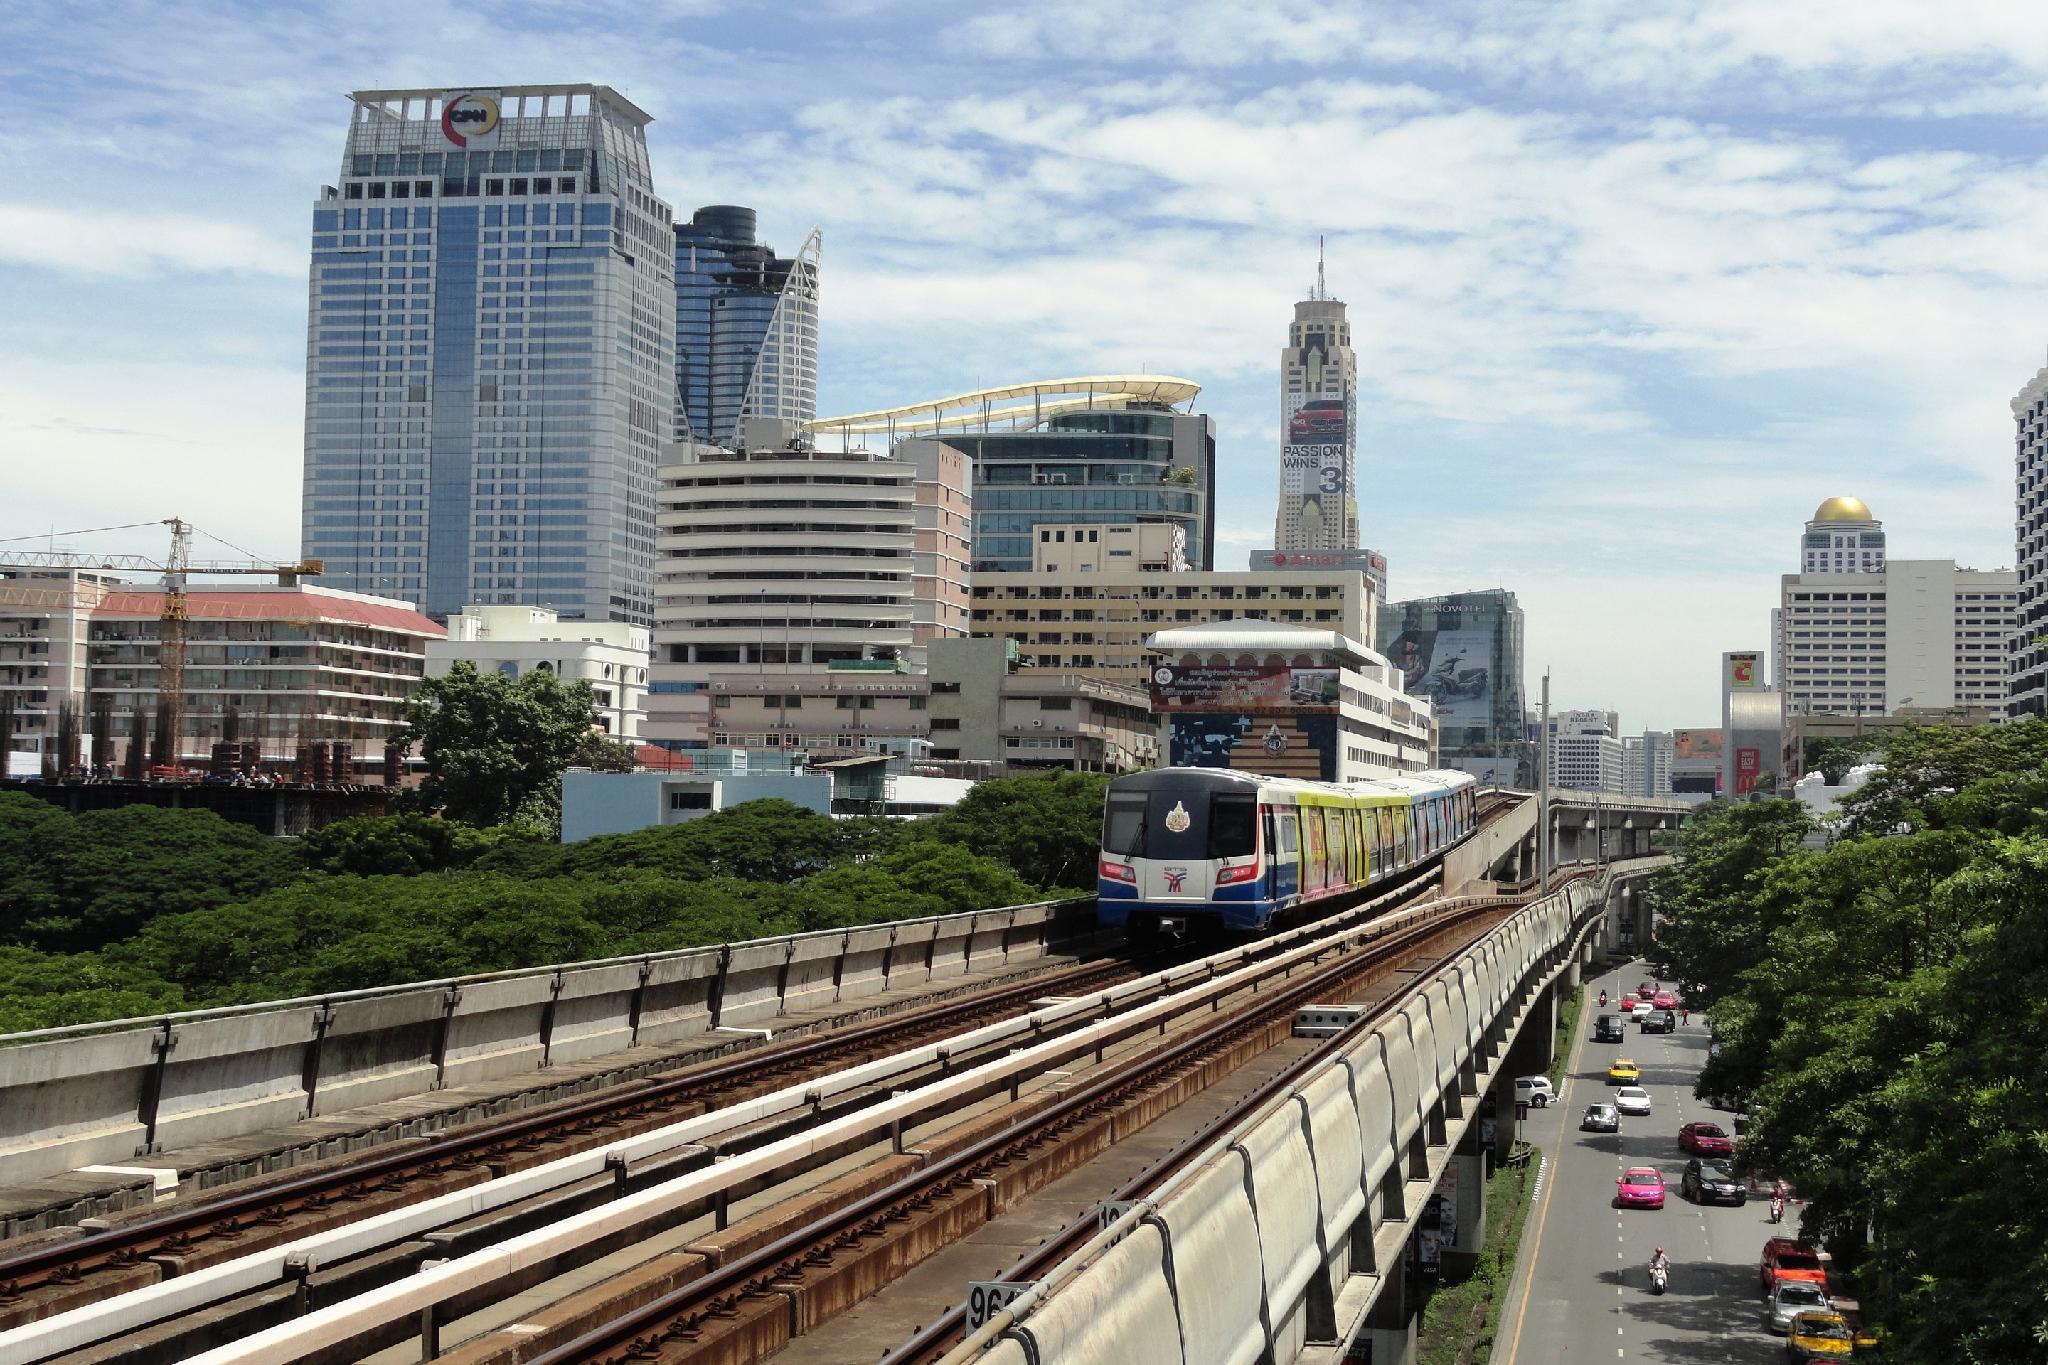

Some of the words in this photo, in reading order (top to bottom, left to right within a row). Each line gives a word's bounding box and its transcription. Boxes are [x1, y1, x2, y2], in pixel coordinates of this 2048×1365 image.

[451, 109, 487, 122] CPN
[1283, 445, 1343, 457] PASSION
[1283, 459, 1322, 468] WINS.
